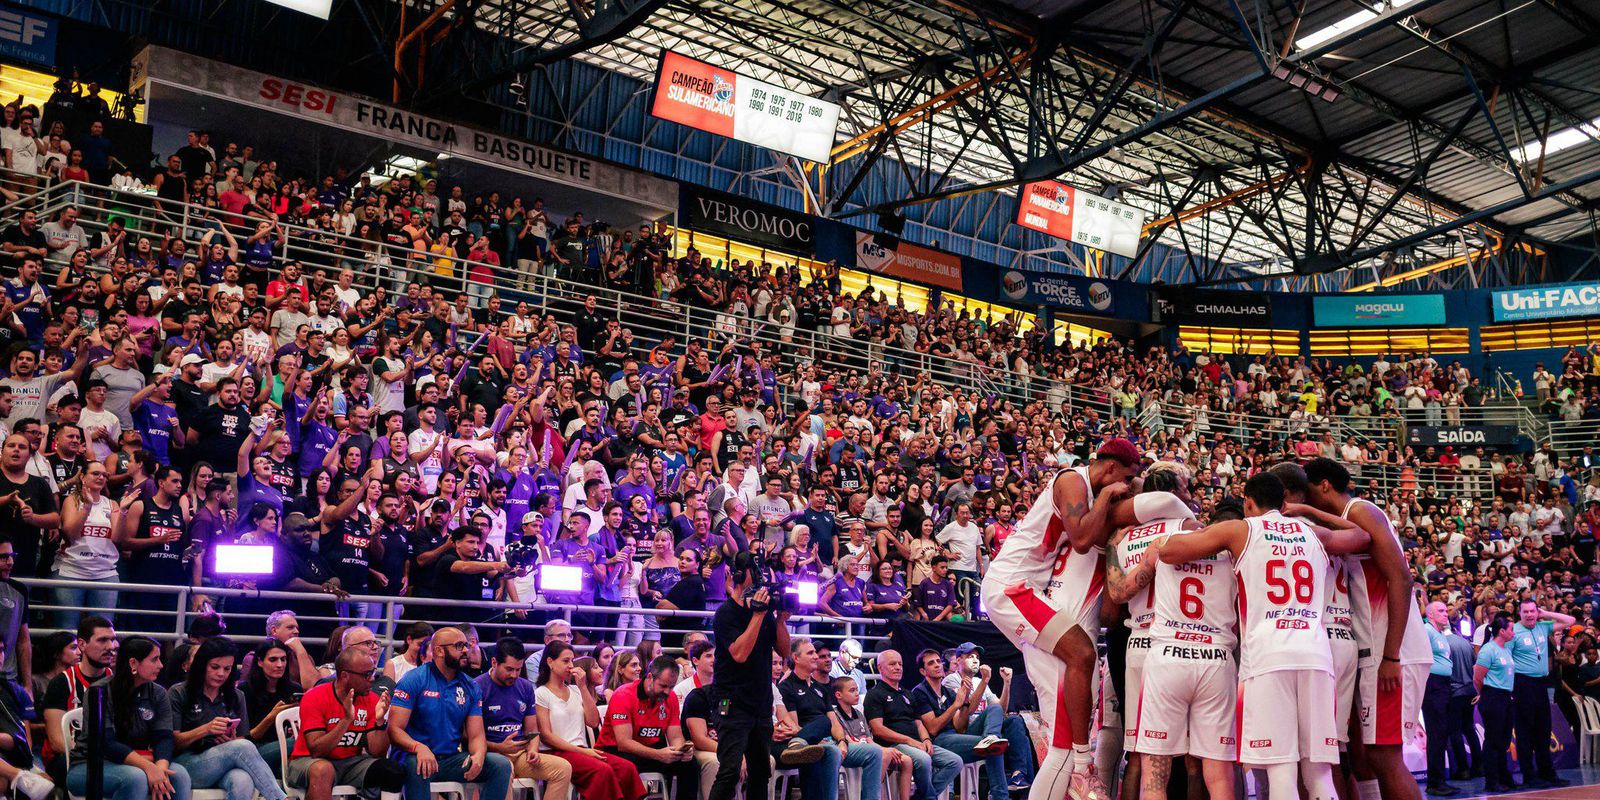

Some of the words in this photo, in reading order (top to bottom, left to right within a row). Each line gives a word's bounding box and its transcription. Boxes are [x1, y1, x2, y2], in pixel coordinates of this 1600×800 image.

[671, 71, 714, 95] CAMPEÃO
[667, 85, 736, 118] SULAMERICANO
[751, 88, 767, 101] 1974
[770, 94, 786, 107] 1975
[789, 100, 805, 112] 1977
[808, 105, 823, 118] 1980
[749, 99, 764, 112] 1990
[768, 104, 783, 118] 1991
[786, 110, 803, 123] 2018
[259, 78, 337, 115] SESI
[356, 102, 459, 147] FRANCA
[473, 133, 592, 180] BASQUETE
[1032, 184, 1057, 201] CAMPEÃO
[697, 197, 811, 243] VEROMOC
[896, 253, 961, 278] MGSPORTS.COM.BR
[1046, 278, 1069, 287] gente
[1501, 286, 1600, 311] Uni-FAC
[1195, 304, 1266, 315] CHMALHAS
[11, 387, 41, 395] RANCA
[1437, 427, 1486, 443] SAÍDA
[281, 486, 287, 495] 6
[1130, 523, 1162, 539] SESI
[1264, 533, 1307, 543] Unimed
[355, 548, 362, 558] 14
[1127, 541, 1152, 551] Unim
[1271, 545, 1287, 556] ZU
[1290, 545, 1306, 556] JR
[1174, 562, 1213, 575] SCALA
[1265, 559, 1315, 605] 58
[1179, 577, 1205, 621] 6
[1265, 608, 1318, 619] NETSHOES
[1165, 619, 1221, 634] NETSHOES
[1278, 620, 1307, 629] FIESP
[1177, 632, 1210, 642] FIESP
[1163, 645, 1227, 661] FREEWAY
[337, 731, 363, 746] ESI
[639, 727, 661, 737] SESI
